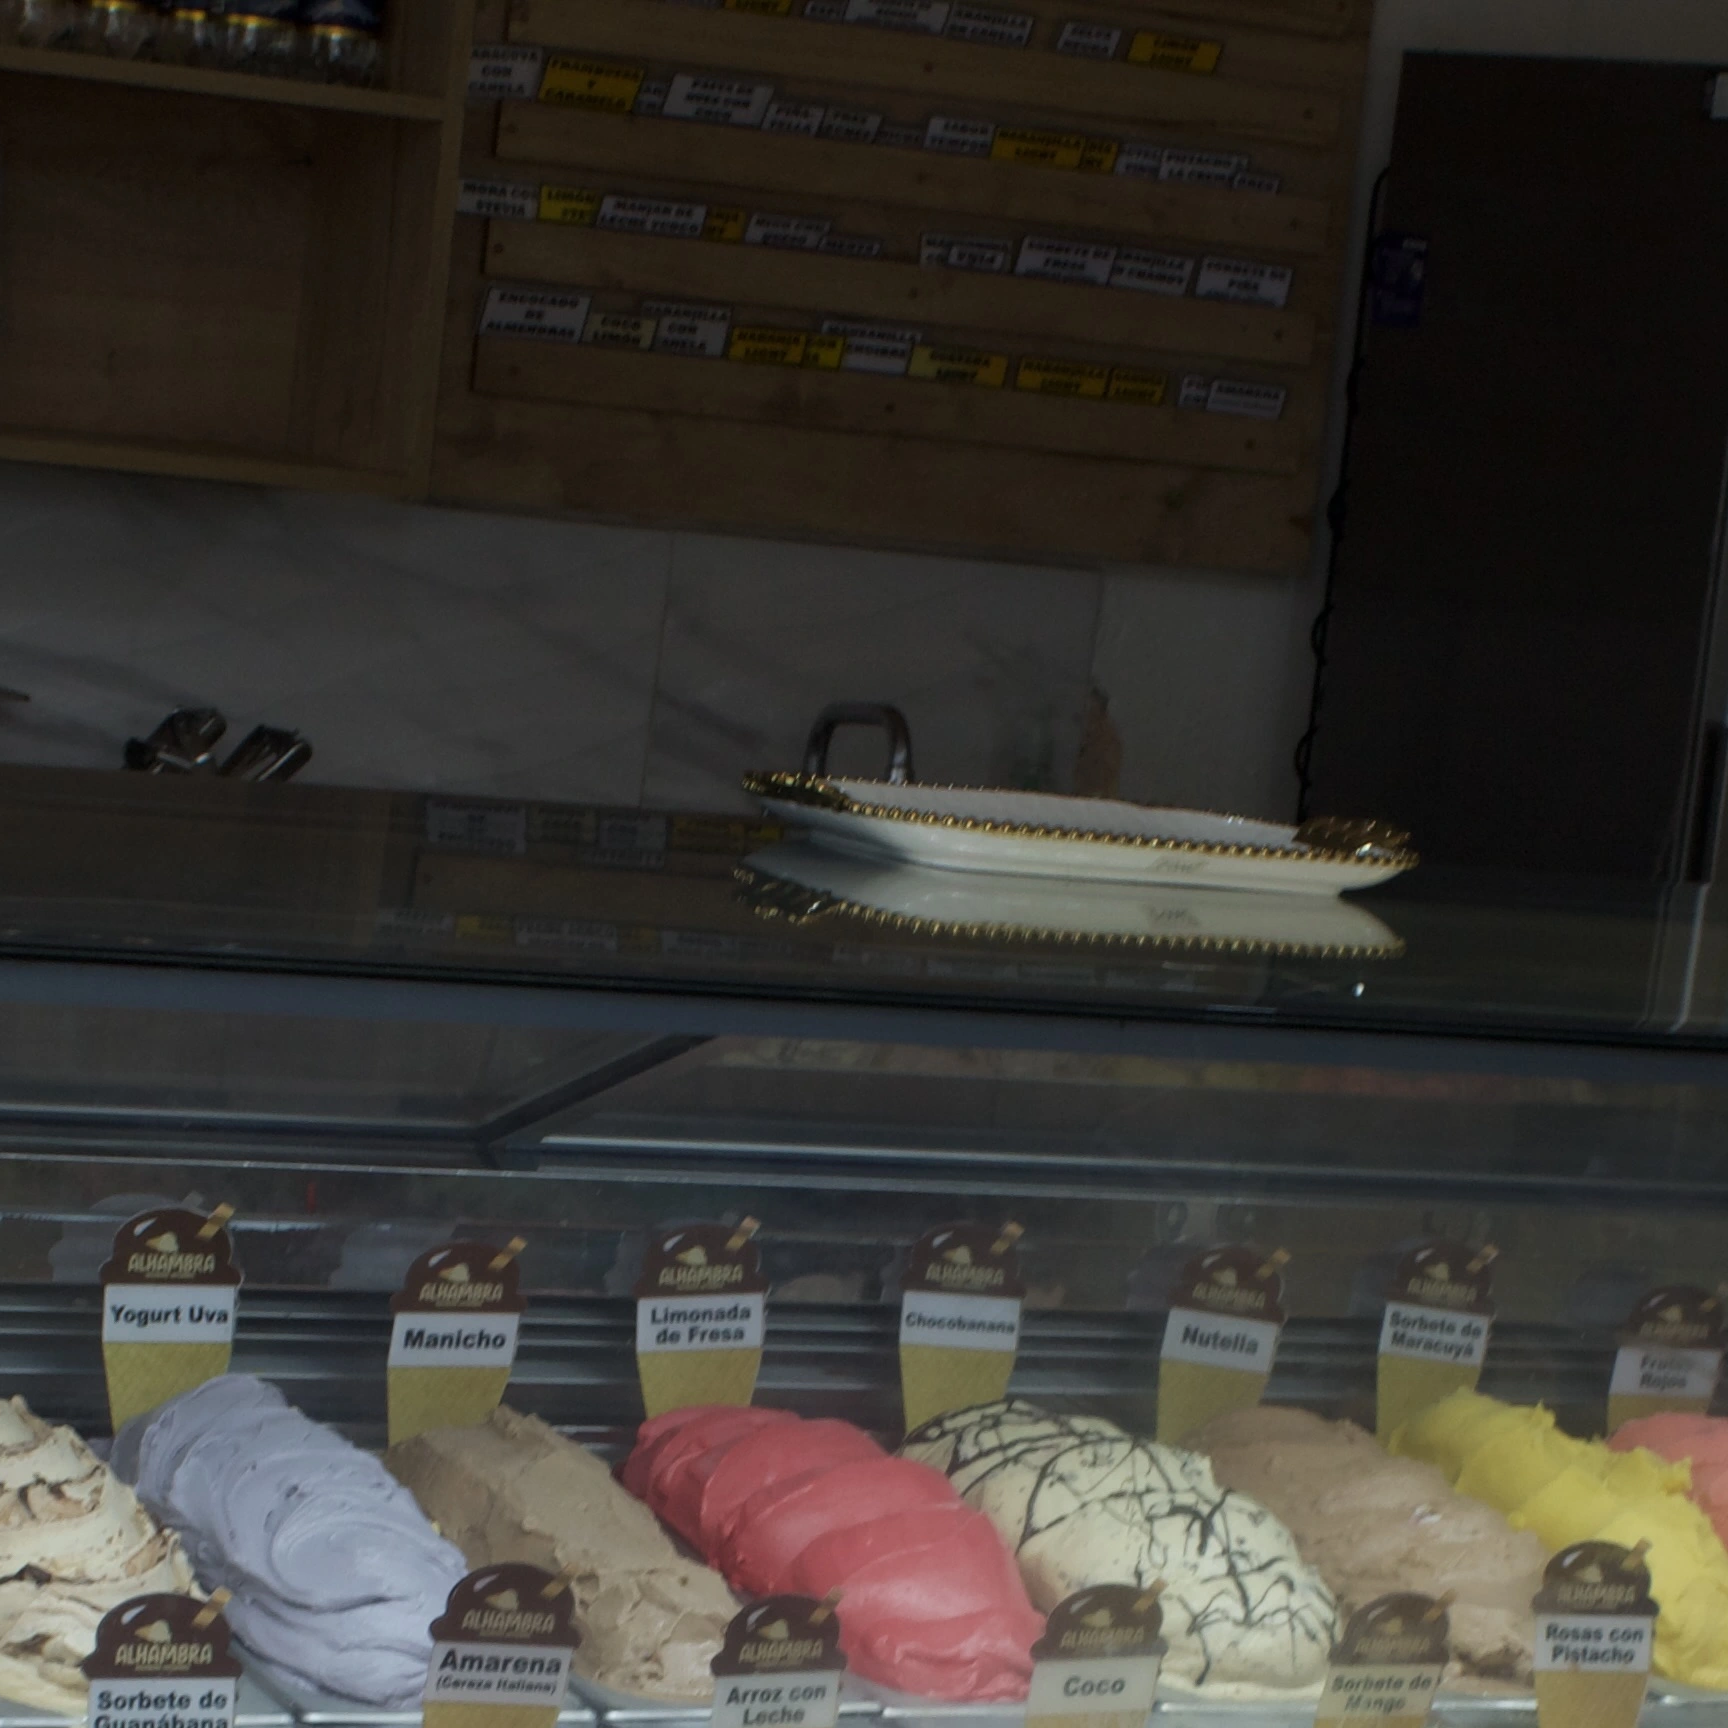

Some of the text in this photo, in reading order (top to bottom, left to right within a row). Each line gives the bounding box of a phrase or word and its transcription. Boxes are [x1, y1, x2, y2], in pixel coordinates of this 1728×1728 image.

[128, 1252, 216, 1274] ALHAMBRA
[658, 1264, 744, 1286] ALHAMBRA
[925, 1262, 1006, 1286] ALHAMBRA
[418, 1281, 504, 1303] ALHAMBRA
[110, 1304, 229, 1328] Yogurt Uva
[650, 1303, 751, 1326] Limonada
[904, 1310, 1016, 1335] Chocobanana
[1388, 1310, 1482, 1338] Sorbete de
[403, 1327, 507, 1351] Manicho
[656, 1325, 746, 1346] de Fresa
[1180, 1324, 1259, 1355] Nutella
[1390, 1331, 1474, 1360] Maracuyá
[461, 1608, 556, 1634] ALHAMBRA
[1546, 1620, 1644, 1642] Rosas con
[114, 1641, 214, 1666] ALHAMBRA
[438, 1647, 562, 1675] Amarena
[738, 1638, 824, 1665] ALHAMBRA
[1550, 1643, 1635, 1665] Pistacho
[725, 1683, 826, 1707] Arroz con
[1063, 1674, 1126, 1698] Coco
[1331, 1673, 1433, 1693] Sorbete de
[96, 1689, 228, 1711] Sorbete de
[742, 1707, 805, 1726] Leche
